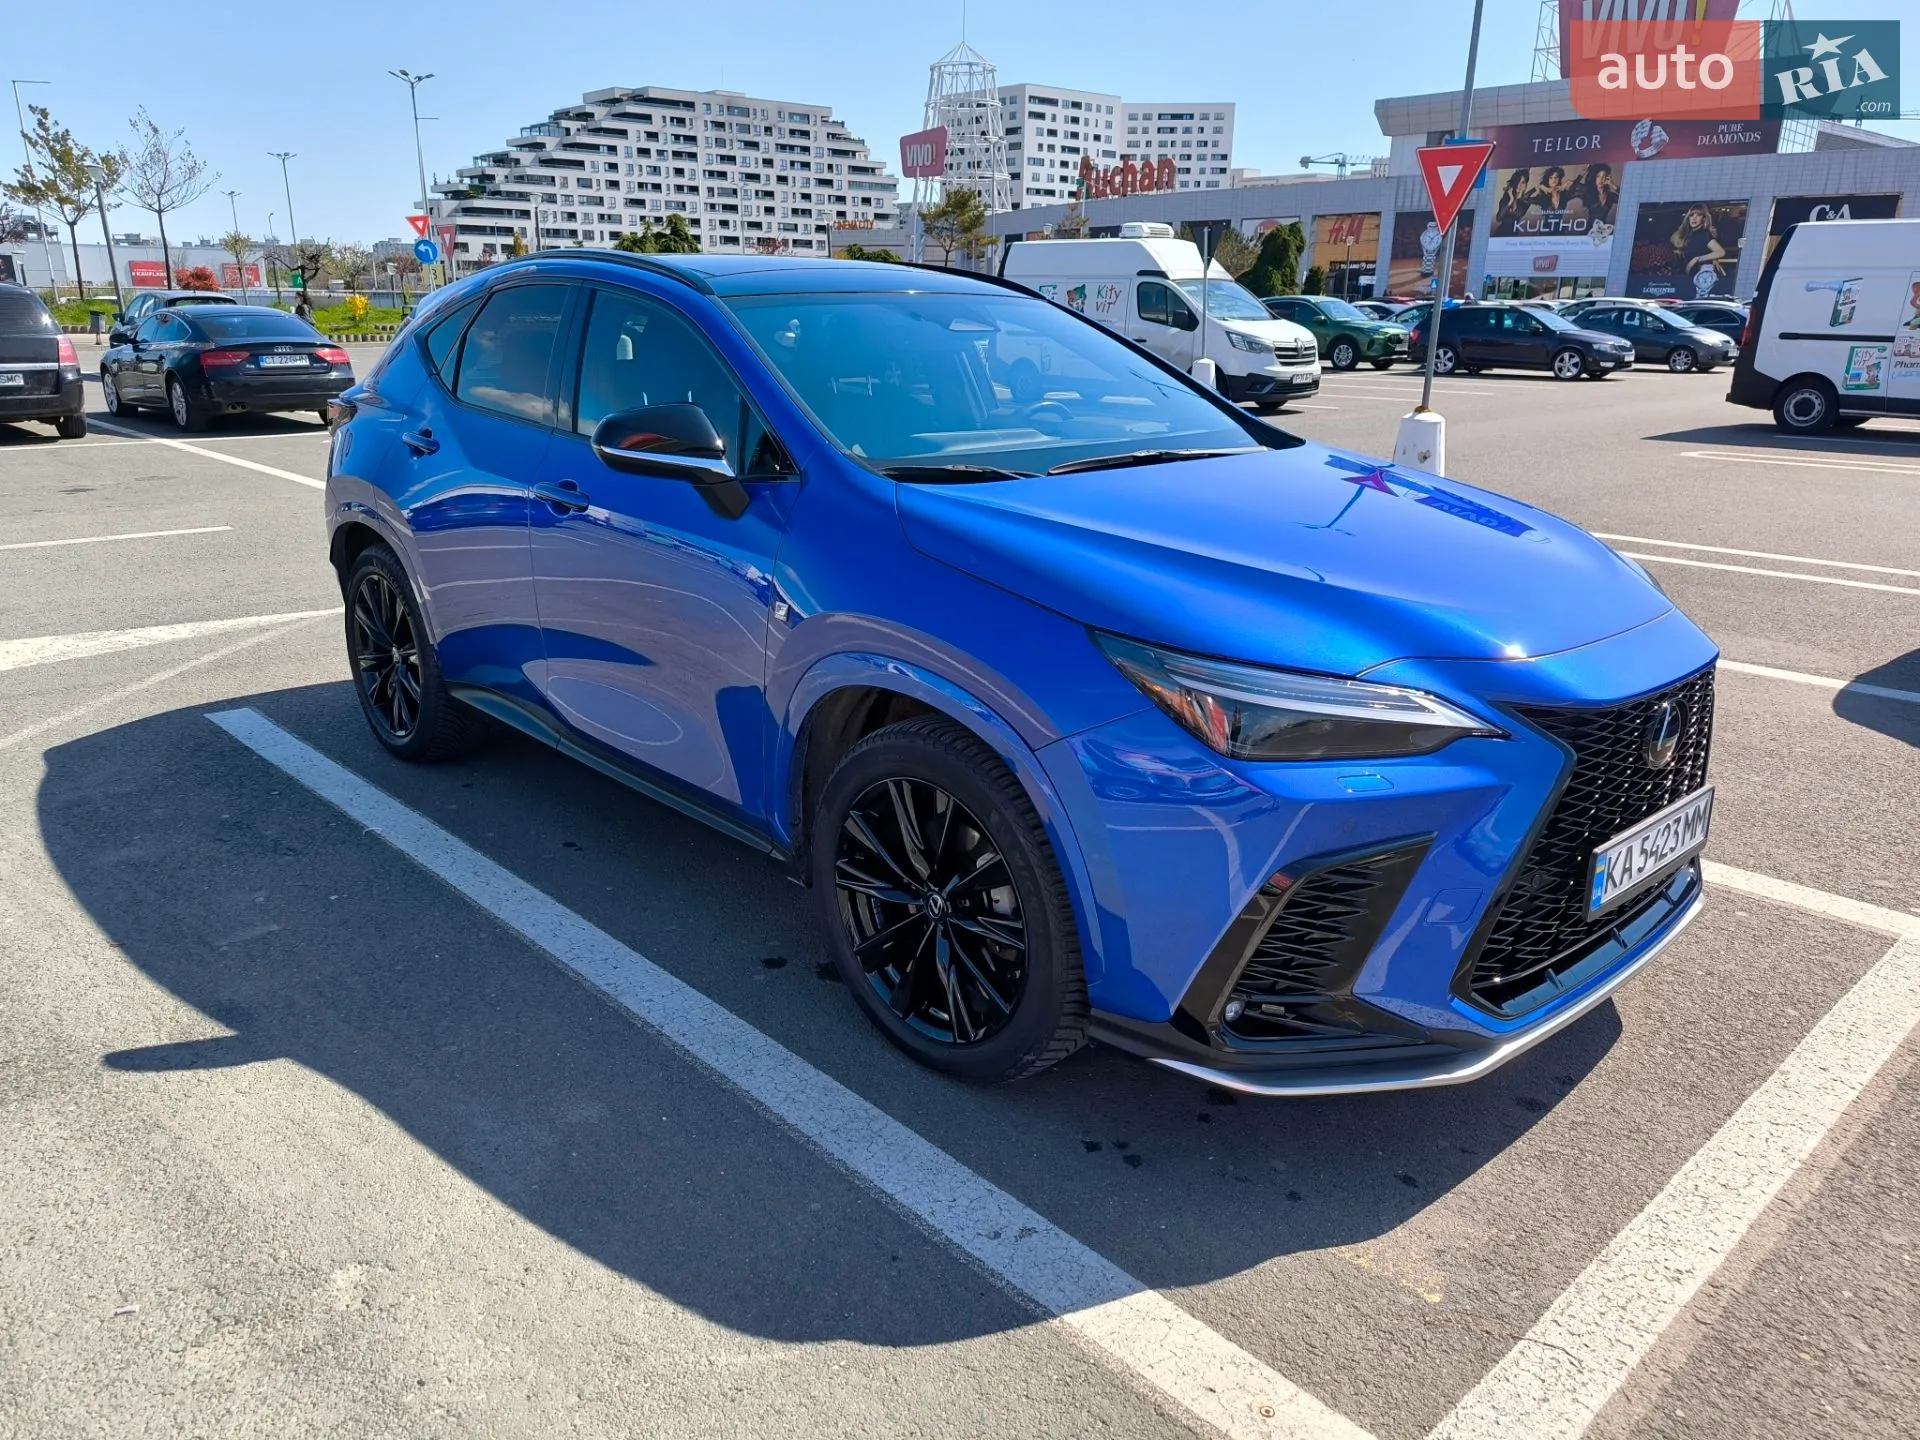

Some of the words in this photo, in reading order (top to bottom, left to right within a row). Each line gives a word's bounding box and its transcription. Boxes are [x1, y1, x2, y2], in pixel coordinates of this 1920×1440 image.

[1717, 122, 1745, 134] PURE
[1532, 134, 1601, 153] TEILOR
[1697, 131, 1762, 146] DIAMONDS
[905, 142, 937, 168] VIVO!
[1075, 154, 1176, 202] Auchan
[1808, 203, 1852, 222] C&A
[859, 219, 874, 230] CITY
[1513, 218, 1587, 233] KULTHO
[1096, 284, 1122, 305] Kity
[1604, 844, 1634, 894] KA
[1637, 815, 1682, 873] 5423
[1681, 801, 1709, 847] MM
